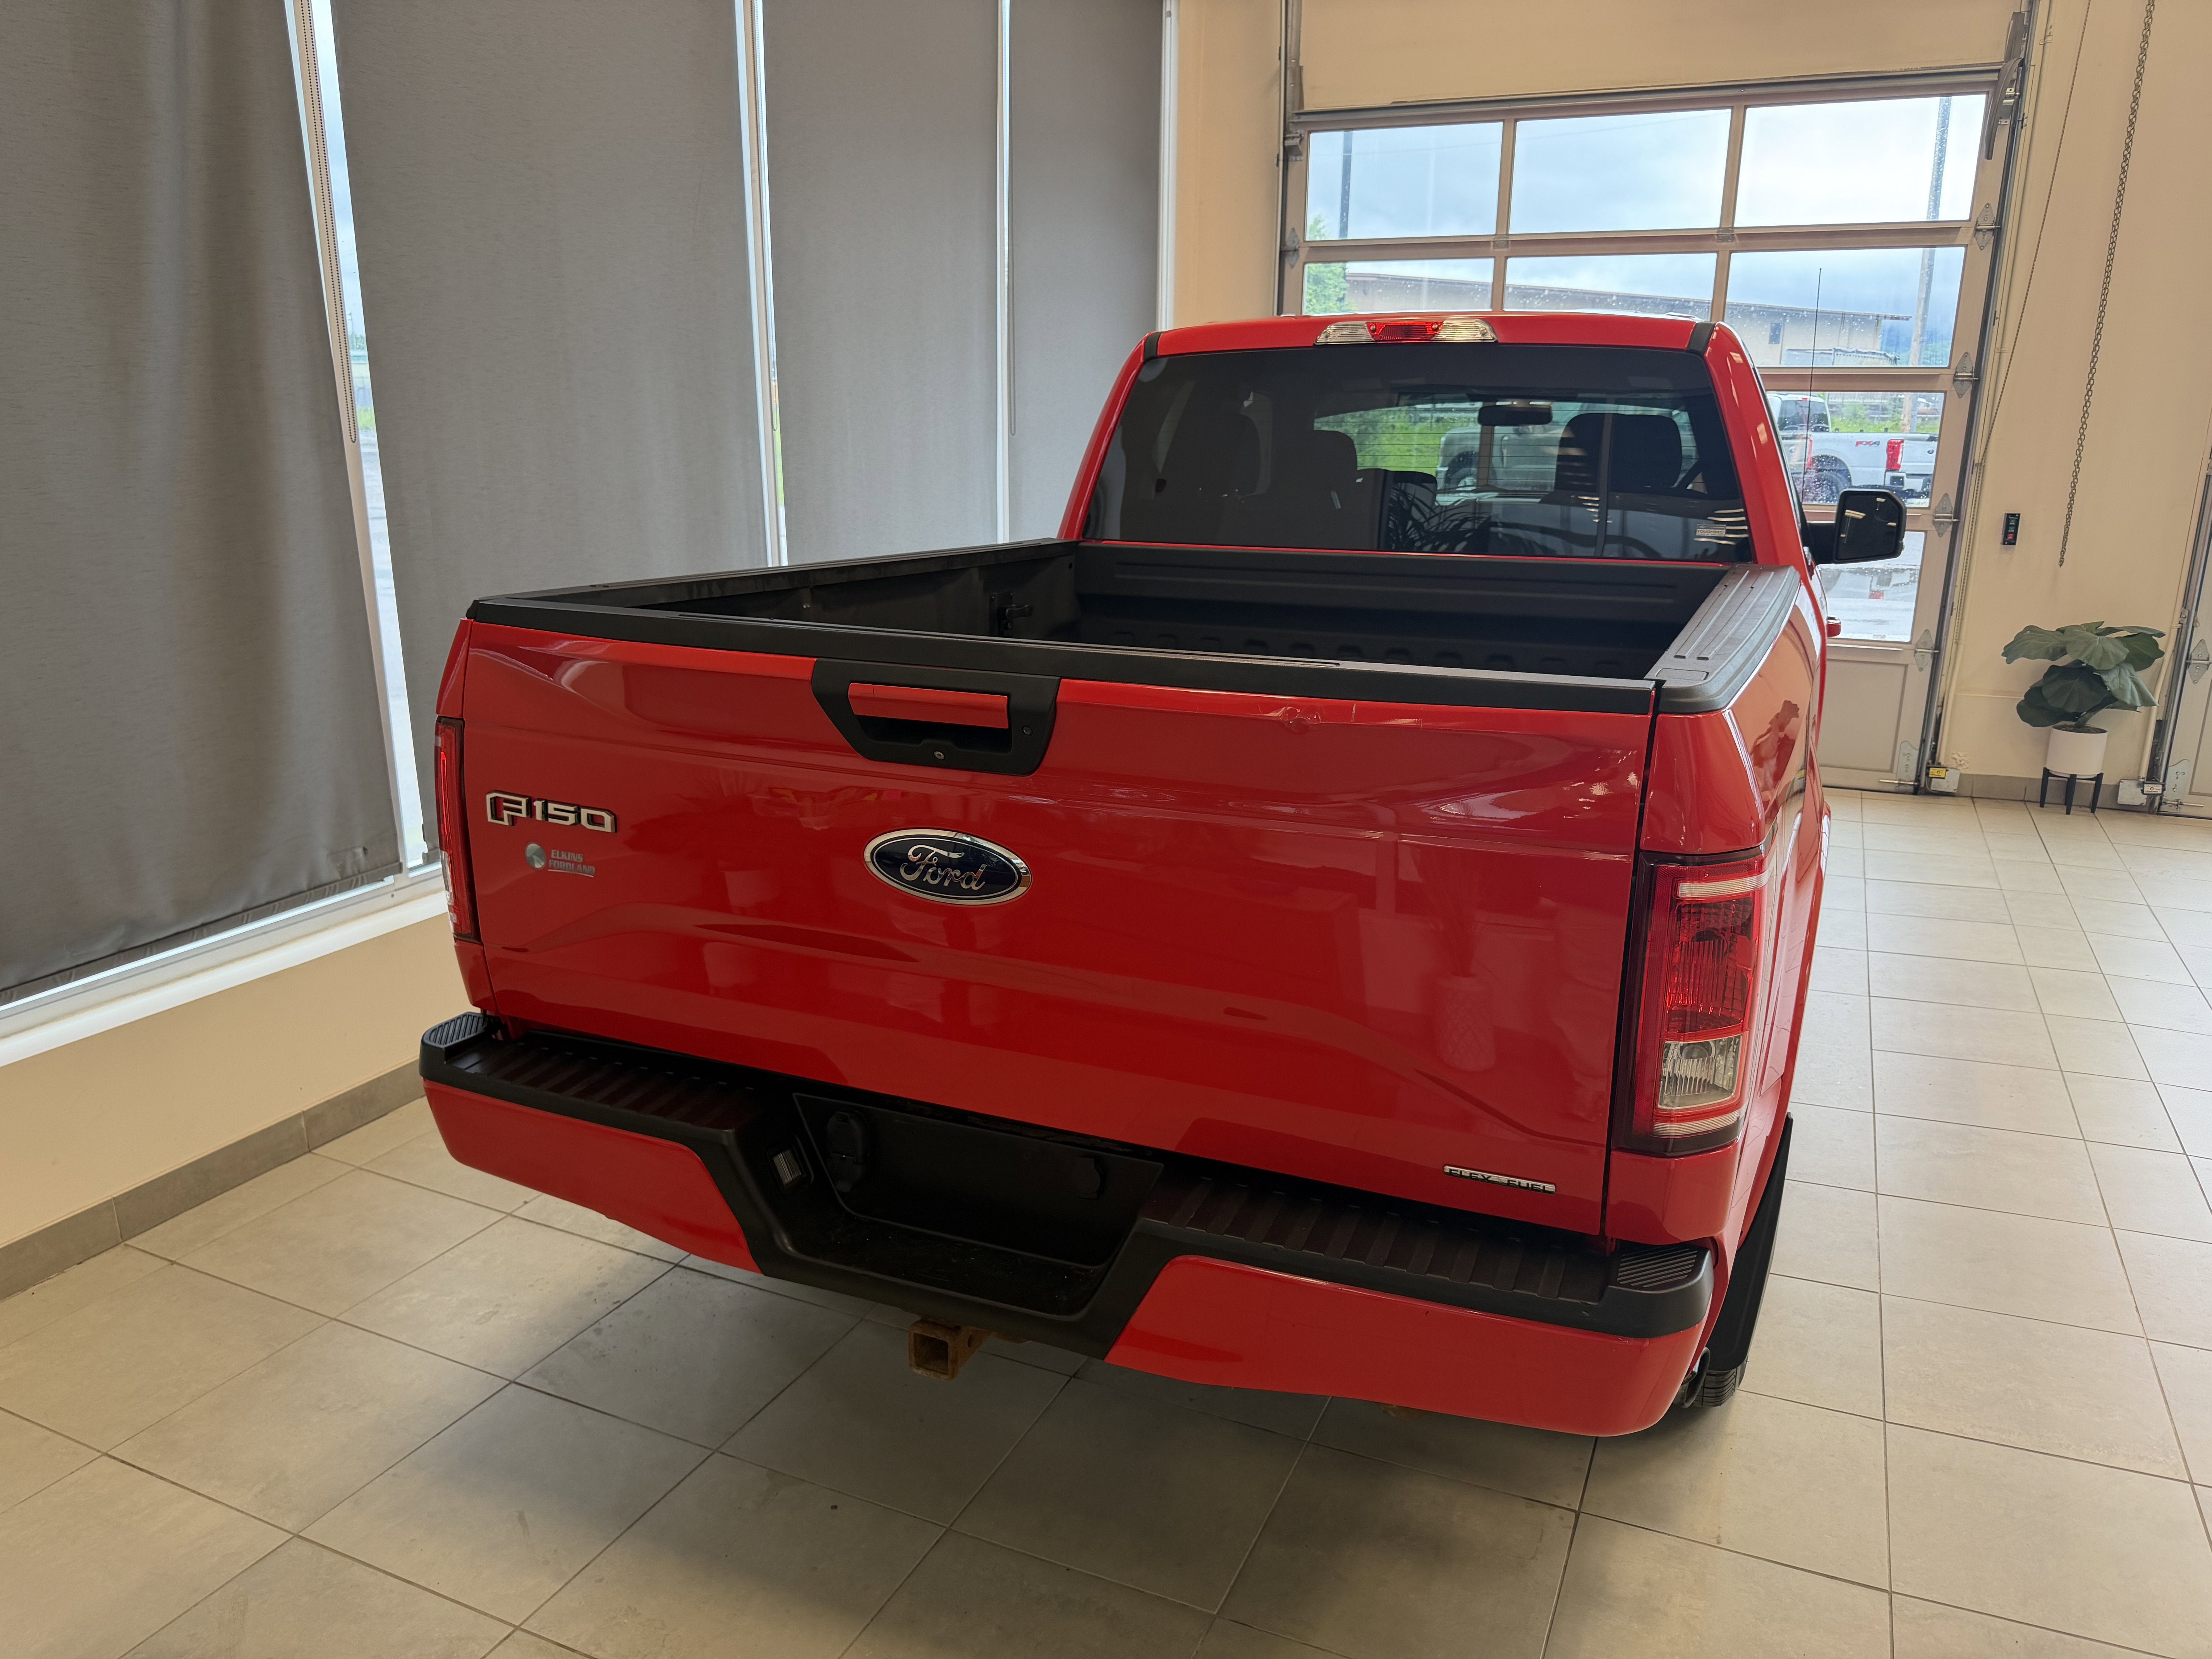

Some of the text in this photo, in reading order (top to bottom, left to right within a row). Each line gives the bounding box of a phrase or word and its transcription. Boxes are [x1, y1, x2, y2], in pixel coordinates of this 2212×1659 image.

[551, 849, 583, 863] ELKINS
[549, 859, 595, 876] FORDLAND
[900, 845, 988, 890] Ford
[1449, 1168, 1555, 1194] FLEX FUEL
